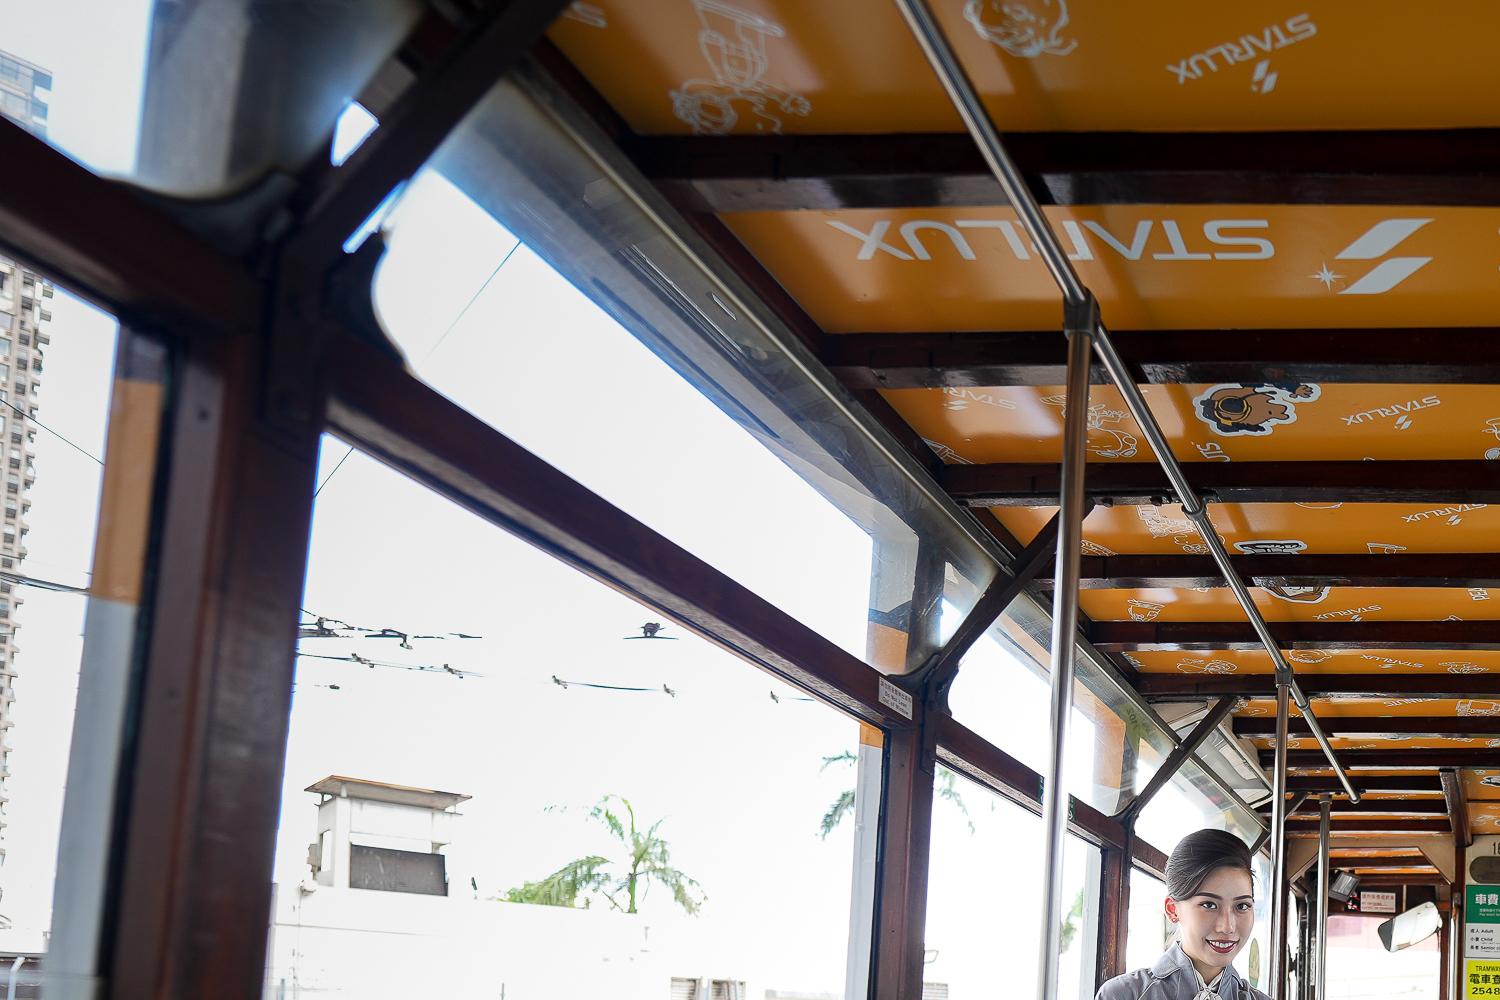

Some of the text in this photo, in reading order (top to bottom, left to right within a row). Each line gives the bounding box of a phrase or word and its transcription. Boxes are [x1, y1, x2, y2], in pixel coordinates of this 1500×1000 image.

[1166, 13, 1318, 85] STARLUX
[1339, 395, 1441, 426] STARLUX
[1312, 603, 1382, 621] STARLUX
[1360, 654, 1425, 669] STARLUX
[1475, 893, 1499, 906] 車費
